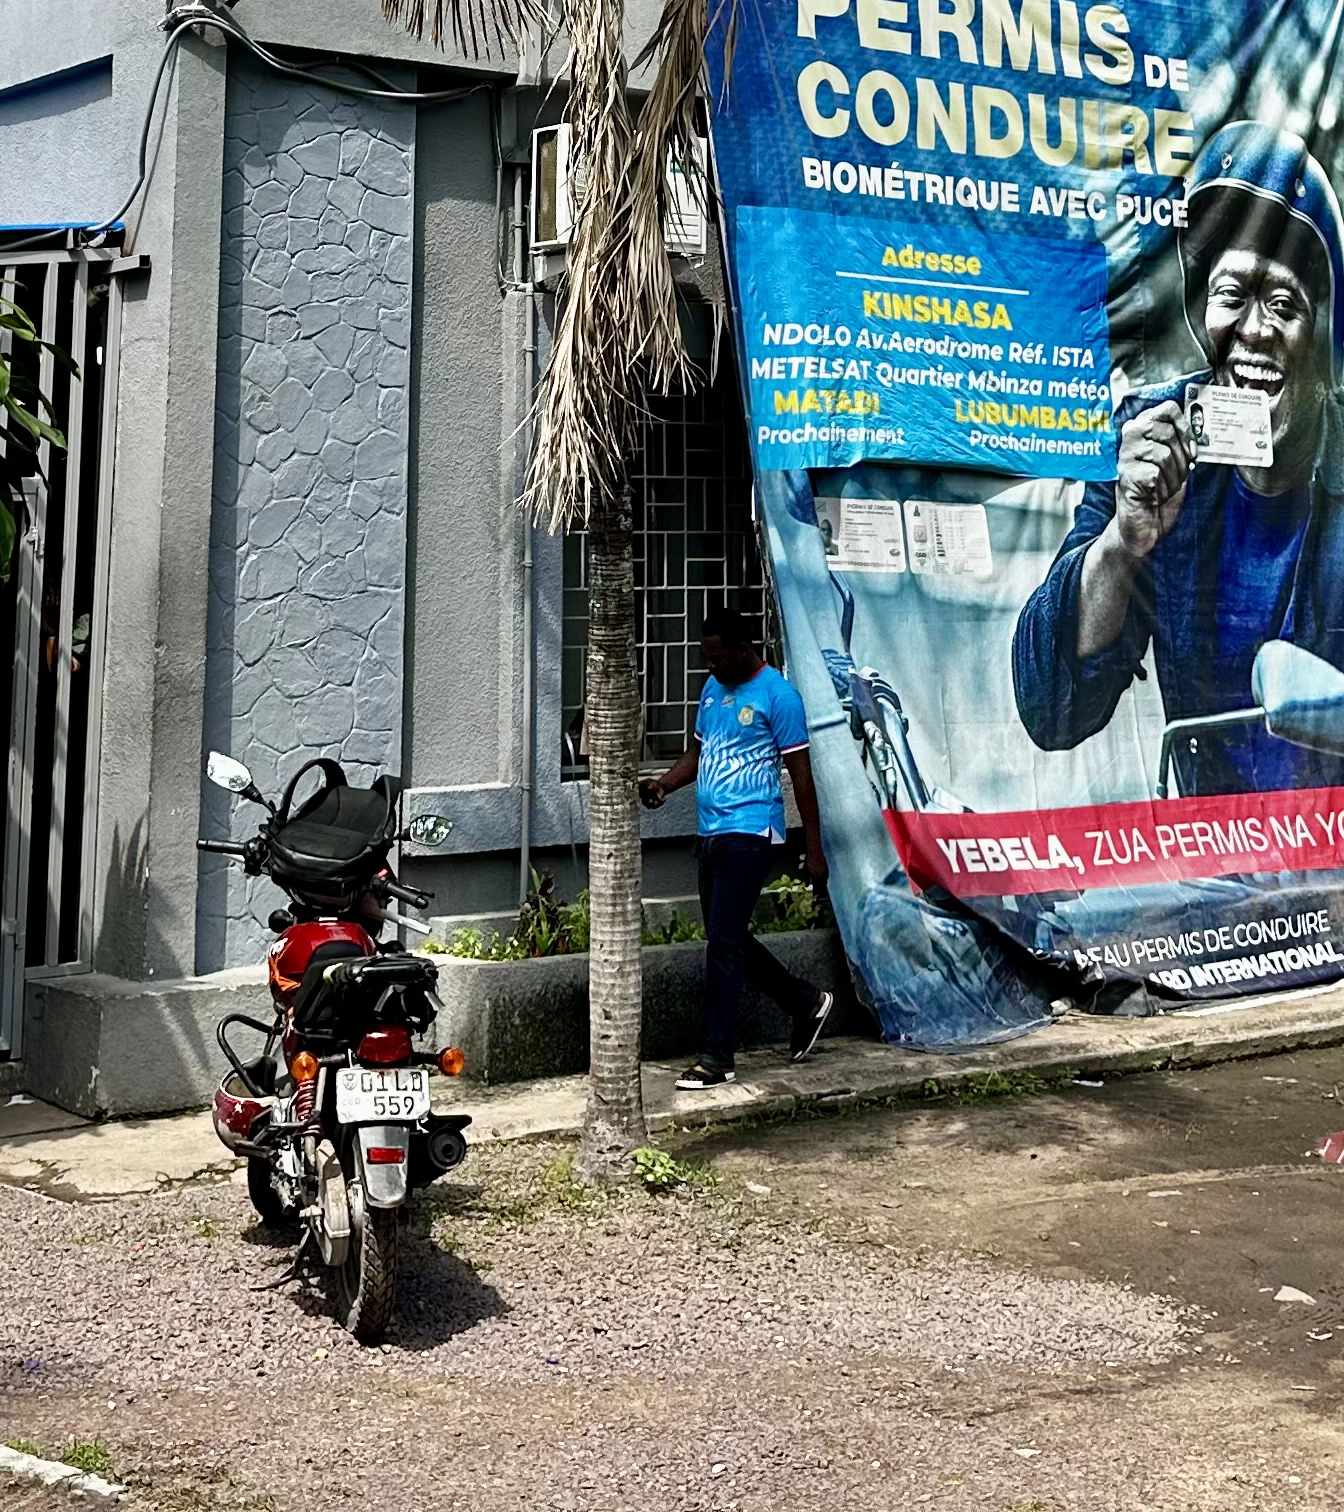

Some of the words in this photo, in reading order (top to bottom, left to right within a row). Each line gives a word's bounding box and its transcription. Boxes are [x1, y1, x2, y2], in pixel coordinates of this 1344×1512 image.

[1143, 53, 1189, 92] DE
[797, 60, 1196, 180] CONDUIRE
[801, 156, 1020, 213] BIOMÉTRIQUE
[1029, 186, 1107, 222] AVEC
[1116, 194, 1190, 228] PUCE
[882, 245, 982, 276] Adresse
[862, 290, 1014, 331] KINSHASA
[762, 323, 852, 347] NDOLO
[1008, 340, 1047, 366] Réf.
[1052, 346, 1095, 369] ISTA
[751, 357, 871, 381] METELSAT
[875, 362, 963, 389] Quartier
[967, 370, 1043, 396] Mbinza
[1048, 377, 1110, 402] météo
[773, 390, 881, 416] MATADI
[954, 398, 1112, 434] LUBUMBASHI
[757, 421, 906, 447] Prochainement
[969, 429, 1102, 456] Prochainement
[936, 833, 1086, 876] YEBELA,
[1084, 828, 1157, 867] ZUA
[1156, 817, 1269, 859] PERMIS
[1269, 814, 1318, 849] NA
[1131, 931, 1204, 965] PERMIS
[1204, 925, 1234, 953] DE
[1233, 909, 1331, 947] CONDUIRE
[1189, 941, 1344, 987] INTERNATIONAL
[373, 1095, 415, 1116] 559
